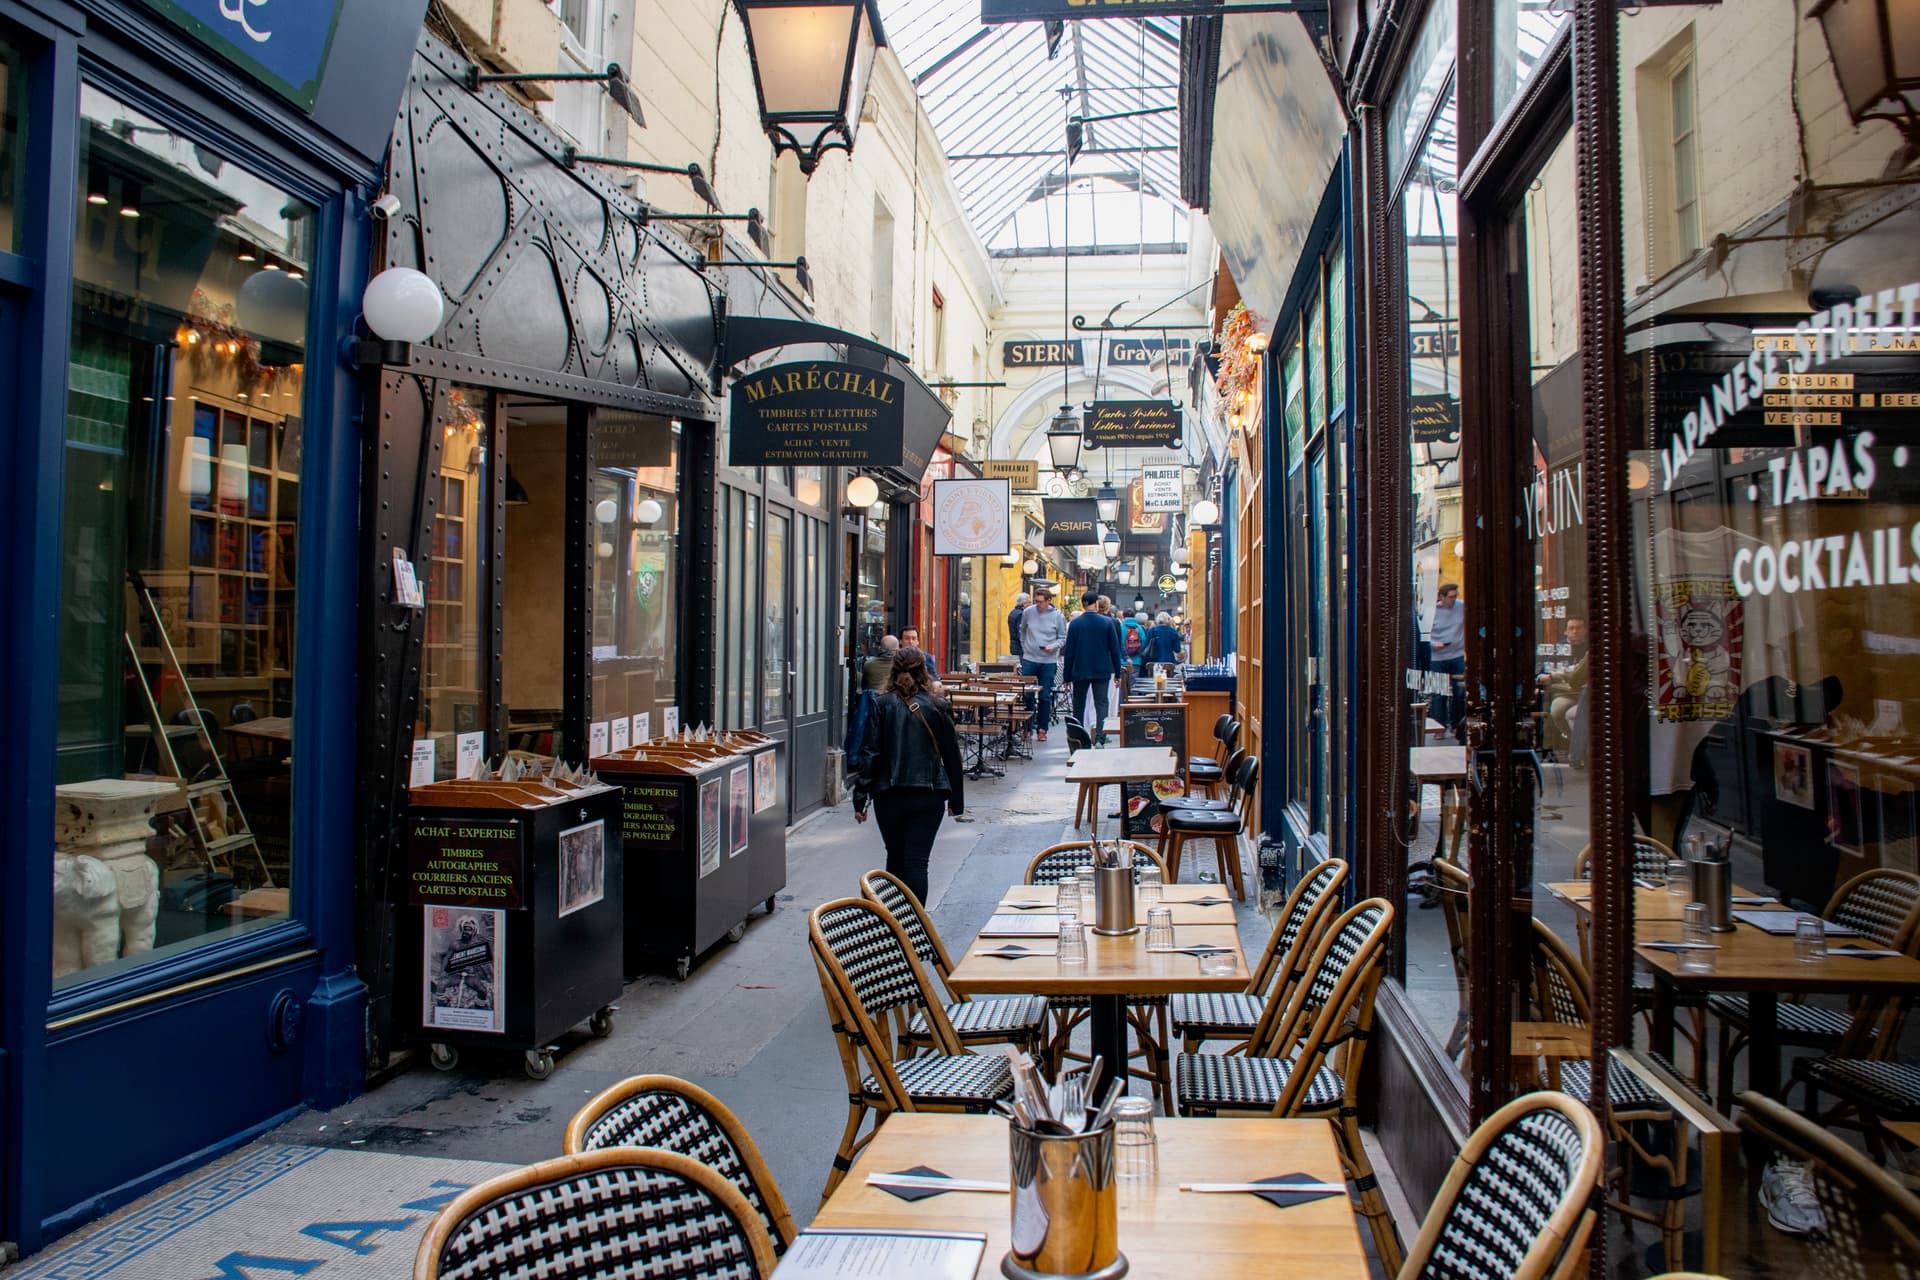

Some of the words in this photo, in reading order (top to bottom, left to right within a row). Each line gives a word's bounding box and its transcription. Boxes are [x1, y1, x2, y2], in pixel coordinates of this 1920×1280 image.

[1794, 283, 1920, 373] STREET
[1756, 339, 1816, 350] CRY
[1011, 343, 1075, 363] STERN
[744, 364, 894, 404] MARÉCHAL
[1767, 376, 1849, 386] ONBURI
[1766, 396, 1851, 405] CHICKEN
[758, 408, 807, 418] TIMBRES
[811, 408, 825, 418] ET
[828, 408, 878, 418] LETTRES
[1097, 407, 1126, 418] Cartes
[1661, 341, 1778, 491] JAPANESE
[1767, 414, 1838, 424] VEGGIE
[767, 422, 809, 432] CARTES
[813, 422, 868, 432] POSTALES
[784, 439, 813, 447] ACHAT
[820, 439, 850, 447] VENTE
[765, 450, 819, 459] ESTIMATION
[822, 451, 868, 459] GRATUITE
[1768, 431, 1875, 506] TAPAS
[1145, 470, 1180, 479] PHILATELIE
[1050, 521, 1092, 531] ASTAIR
[1655, 582, 1743, 601] JAPANES
[634, 787, 679, 797] EXPERTISE
[624, 803, 653, 811] IMBRES
[623, 812, 664, 820] OGRAPHES
[642, 823, 675, 831] ANCIENS
[414, 826, 451, 837] ACHAT
[459, 828, 516, 839] EXPERTISE
[440, 847, 484, 858] TIMBRES
[427, 860, 498, 871] AUTOGRAPHES
[412, 872, 467, 883] COURRIERS
[469, 875, 513, 885] ANCIENS
[418, 885, 456, 895] CARTES
[458, 887, 507, 897] POSTALES
